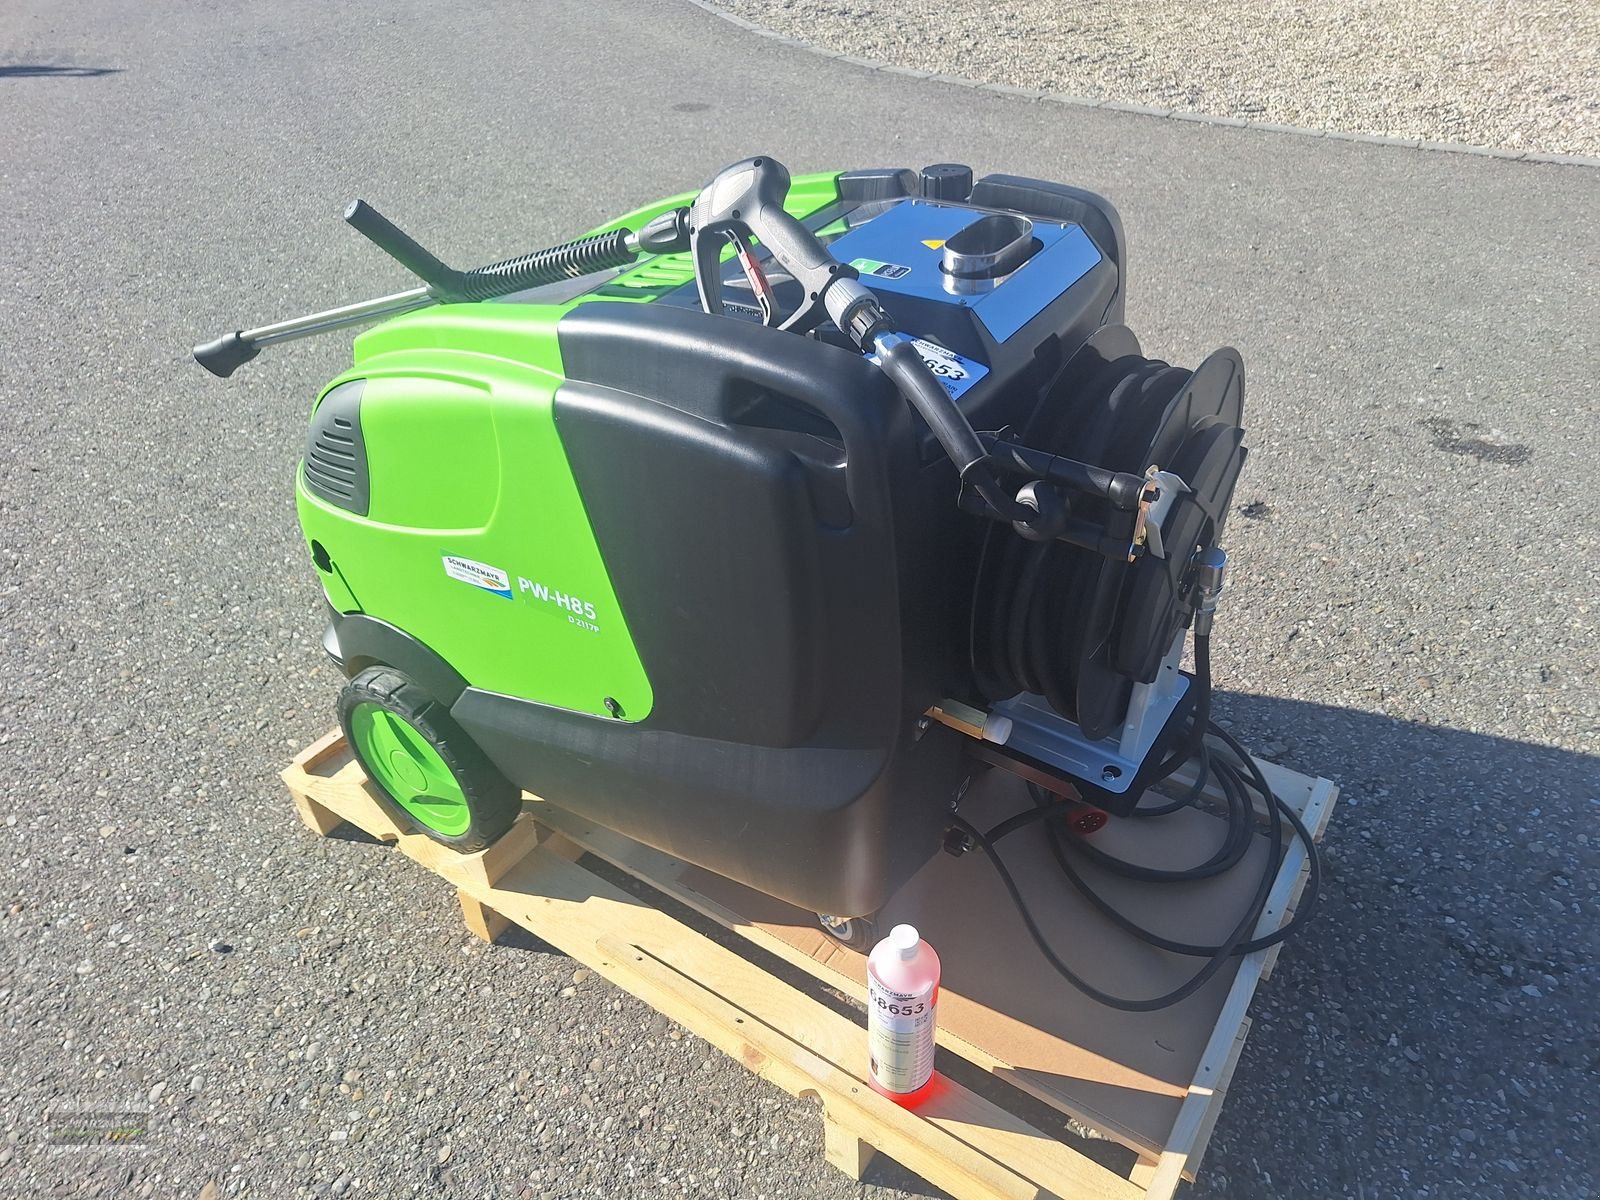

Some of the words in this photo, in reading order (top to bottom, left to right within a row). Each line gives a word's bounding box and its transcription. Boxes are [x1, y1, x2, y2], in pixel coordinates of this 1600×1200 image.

[920, 355, 965, 381] 653
[447, 557, 500, 581] SCHWARZMAYR
[517, 576, 597, 620] PW-H85
[869, 988, 925, 1016] 68653
